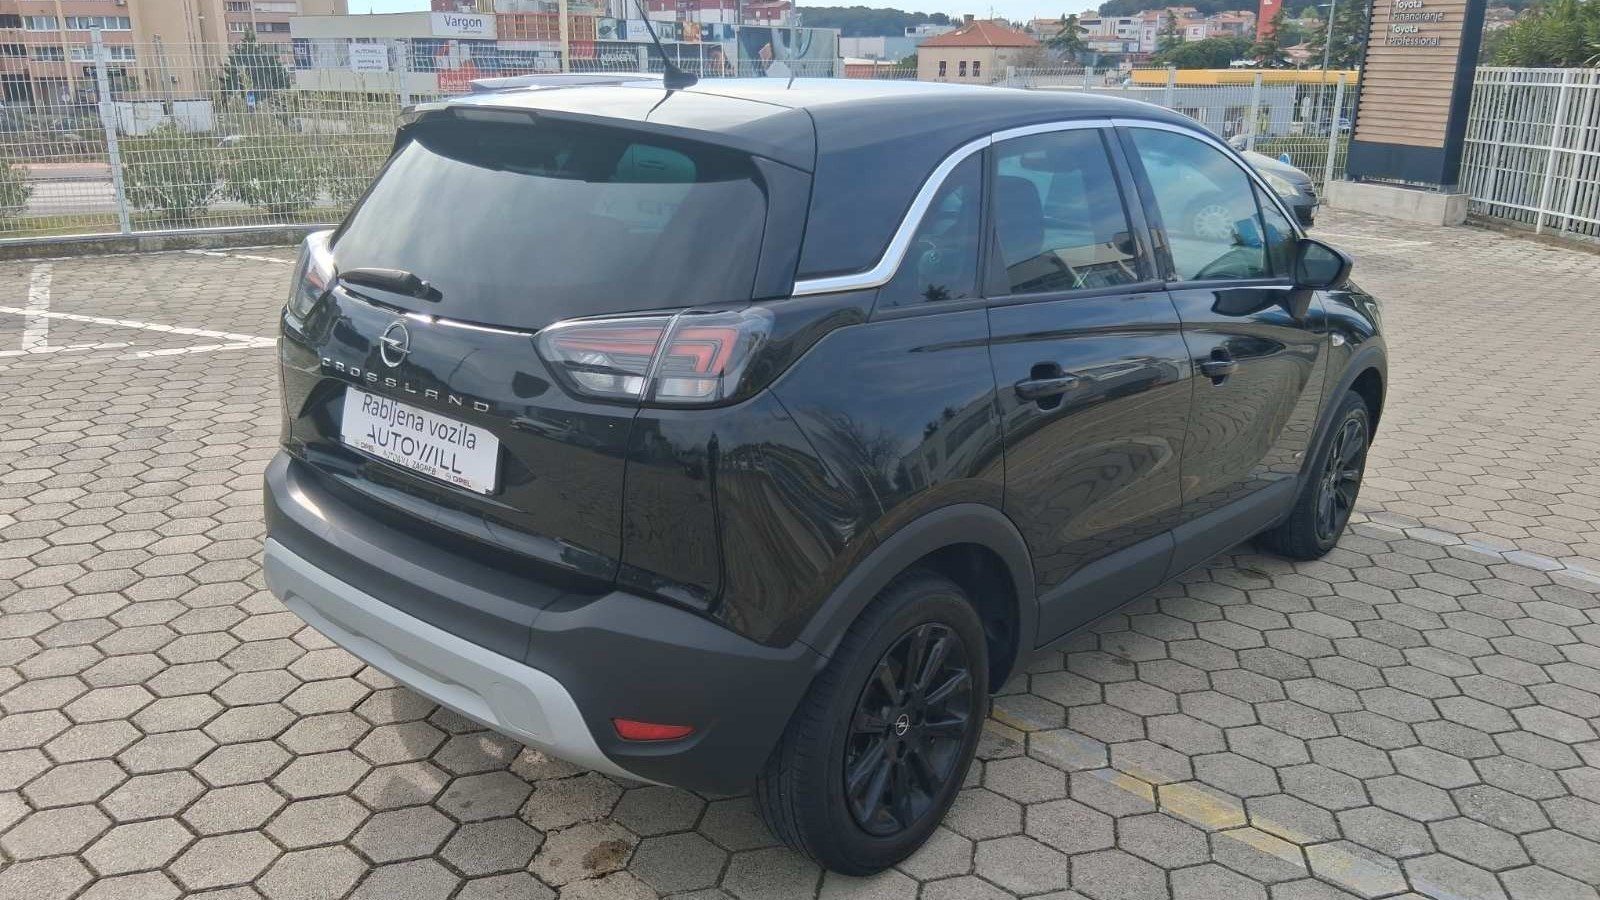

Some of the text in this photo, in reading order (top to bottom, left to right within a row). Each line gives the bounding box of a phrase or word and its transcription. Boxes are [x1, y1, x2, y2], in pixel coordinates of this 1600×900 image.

[1395, 0, 1423, 11] Toyota
[443, 14, 482, 30] Vargon
[1391, 24, 1419, 34] Toyota
[1389, 36, 1440, 45] Professional
[322, 357, 489, 412] CROSSLAND
[362, 393, 477, 451] Rabljena vozila
[367, 424, 462, 474] AUTOWILL
[452, 475, 473, 489] OPEL
